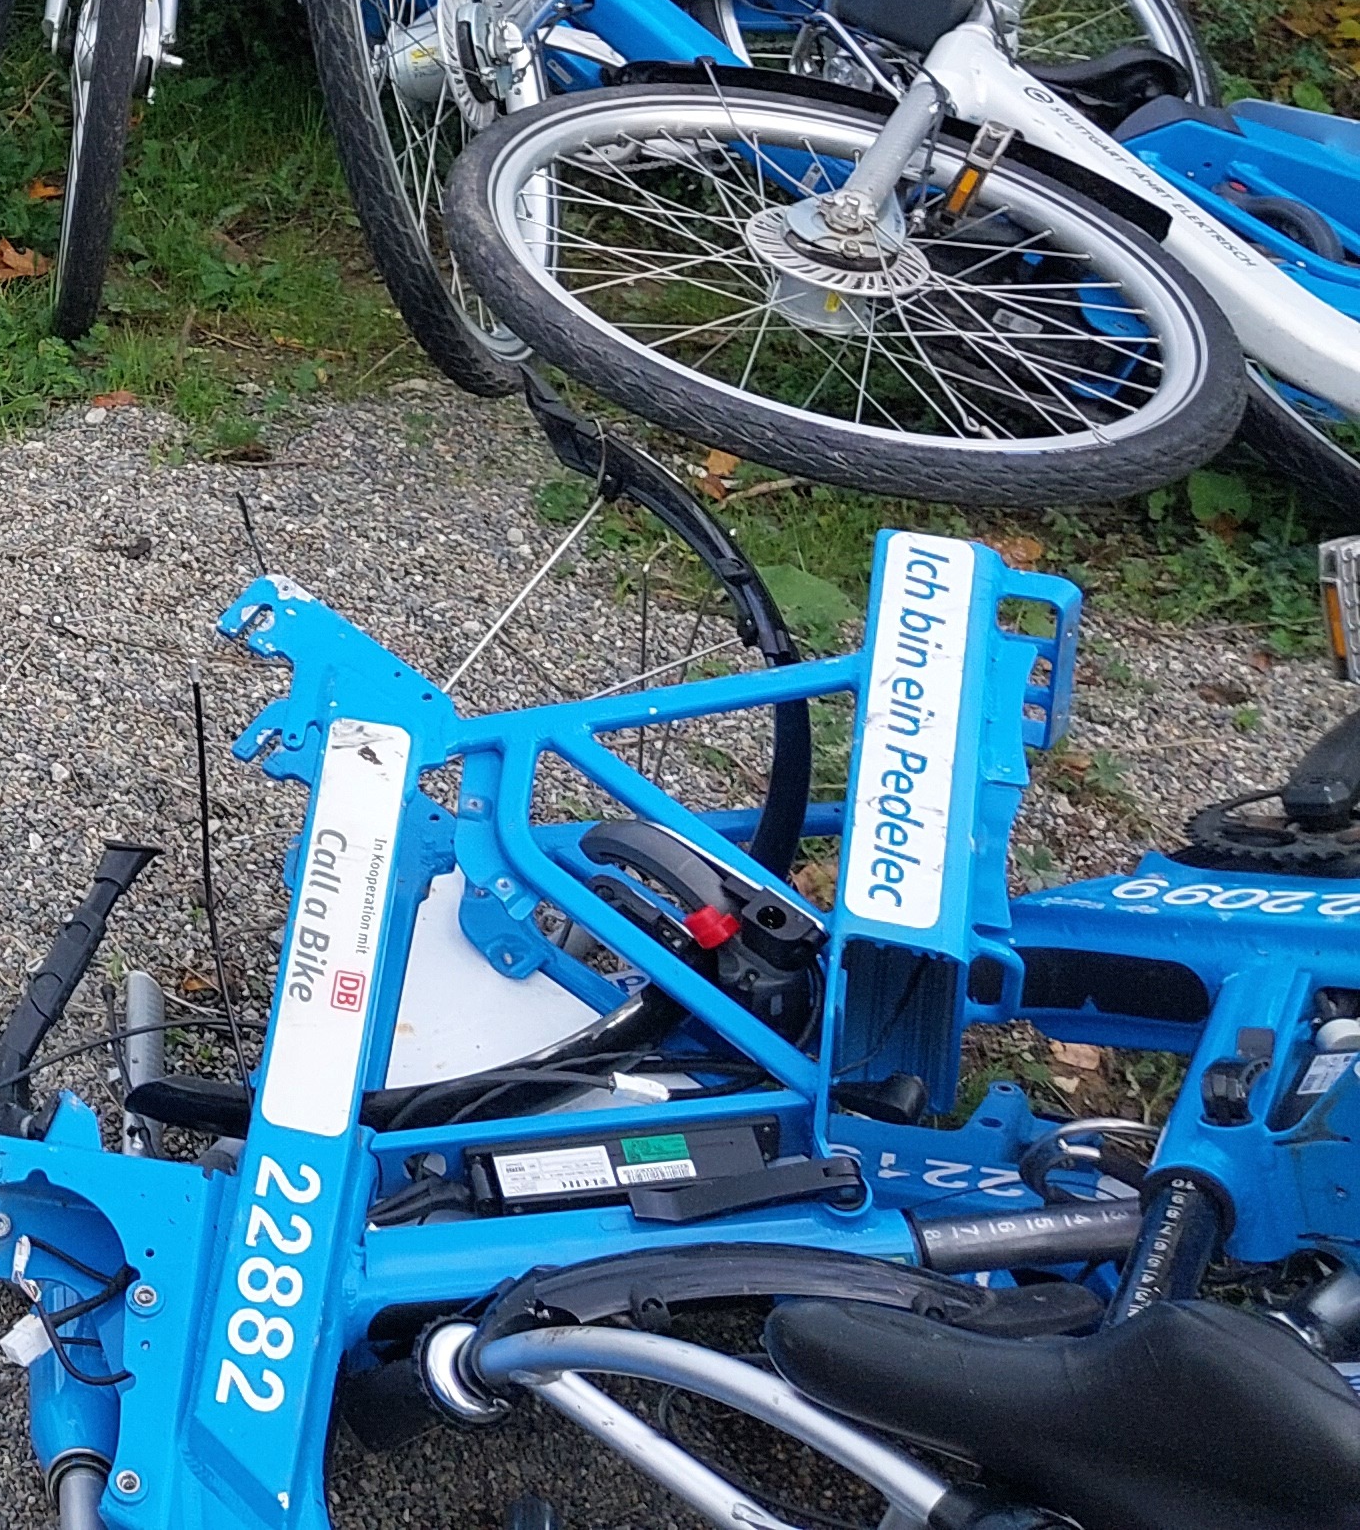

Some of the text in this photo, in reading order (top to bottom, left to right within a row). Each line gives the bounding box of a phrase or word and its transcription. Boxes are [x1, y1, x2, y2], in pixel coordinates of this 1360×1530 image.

[1050, 106, 1127, 164] STUTTGART
[1171, 203, 1259, 267] ELEKTRISCH
[866, 545, 951, 909] Ich bin ein Pedelec
[288, 828, 348, 1004] Call a Bike
[334, 836, 388, 1009] In Kooperation mit DB
[214, 1154, 322, 1413] 22882
